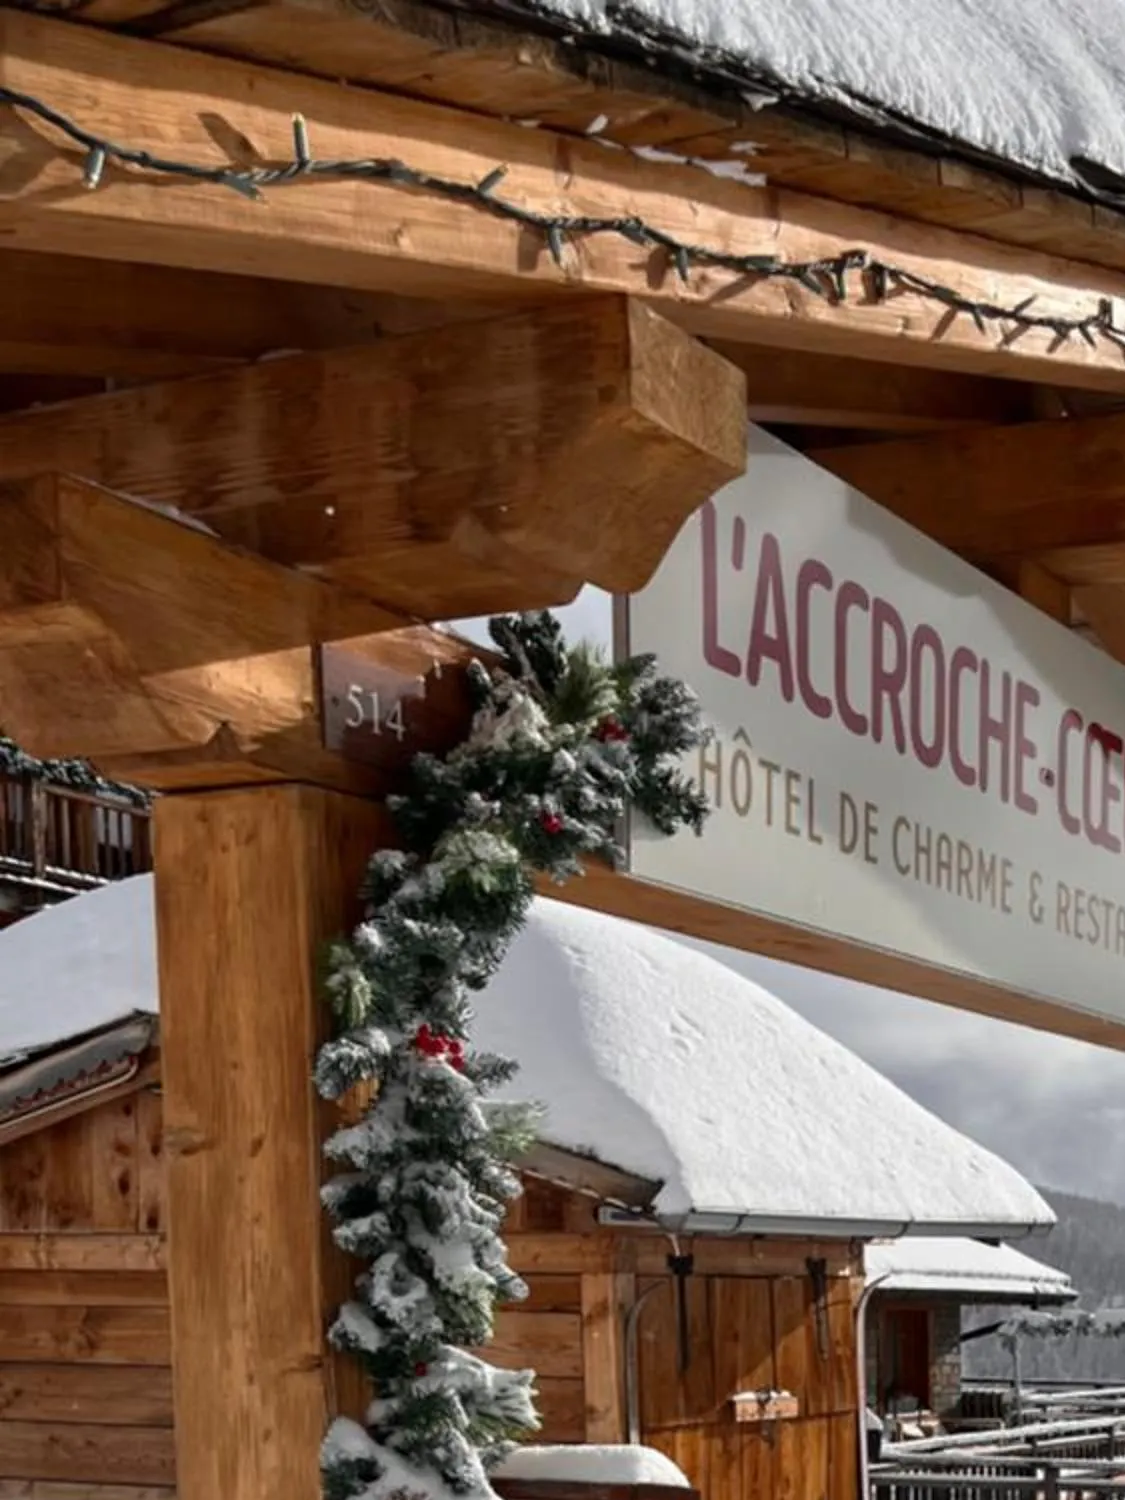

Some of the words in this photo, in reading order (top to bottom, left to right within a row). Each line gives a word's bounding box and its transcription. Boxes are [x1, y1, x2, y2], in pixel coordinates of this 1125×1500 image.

[346, 684, 406, 742] 514
[699, 727, 823, 845] HÔTEL
[839, 790, 878, 865] DE
[892, 815, 1013, 914] CHARME
[1029, 871, 1044, 925] &
